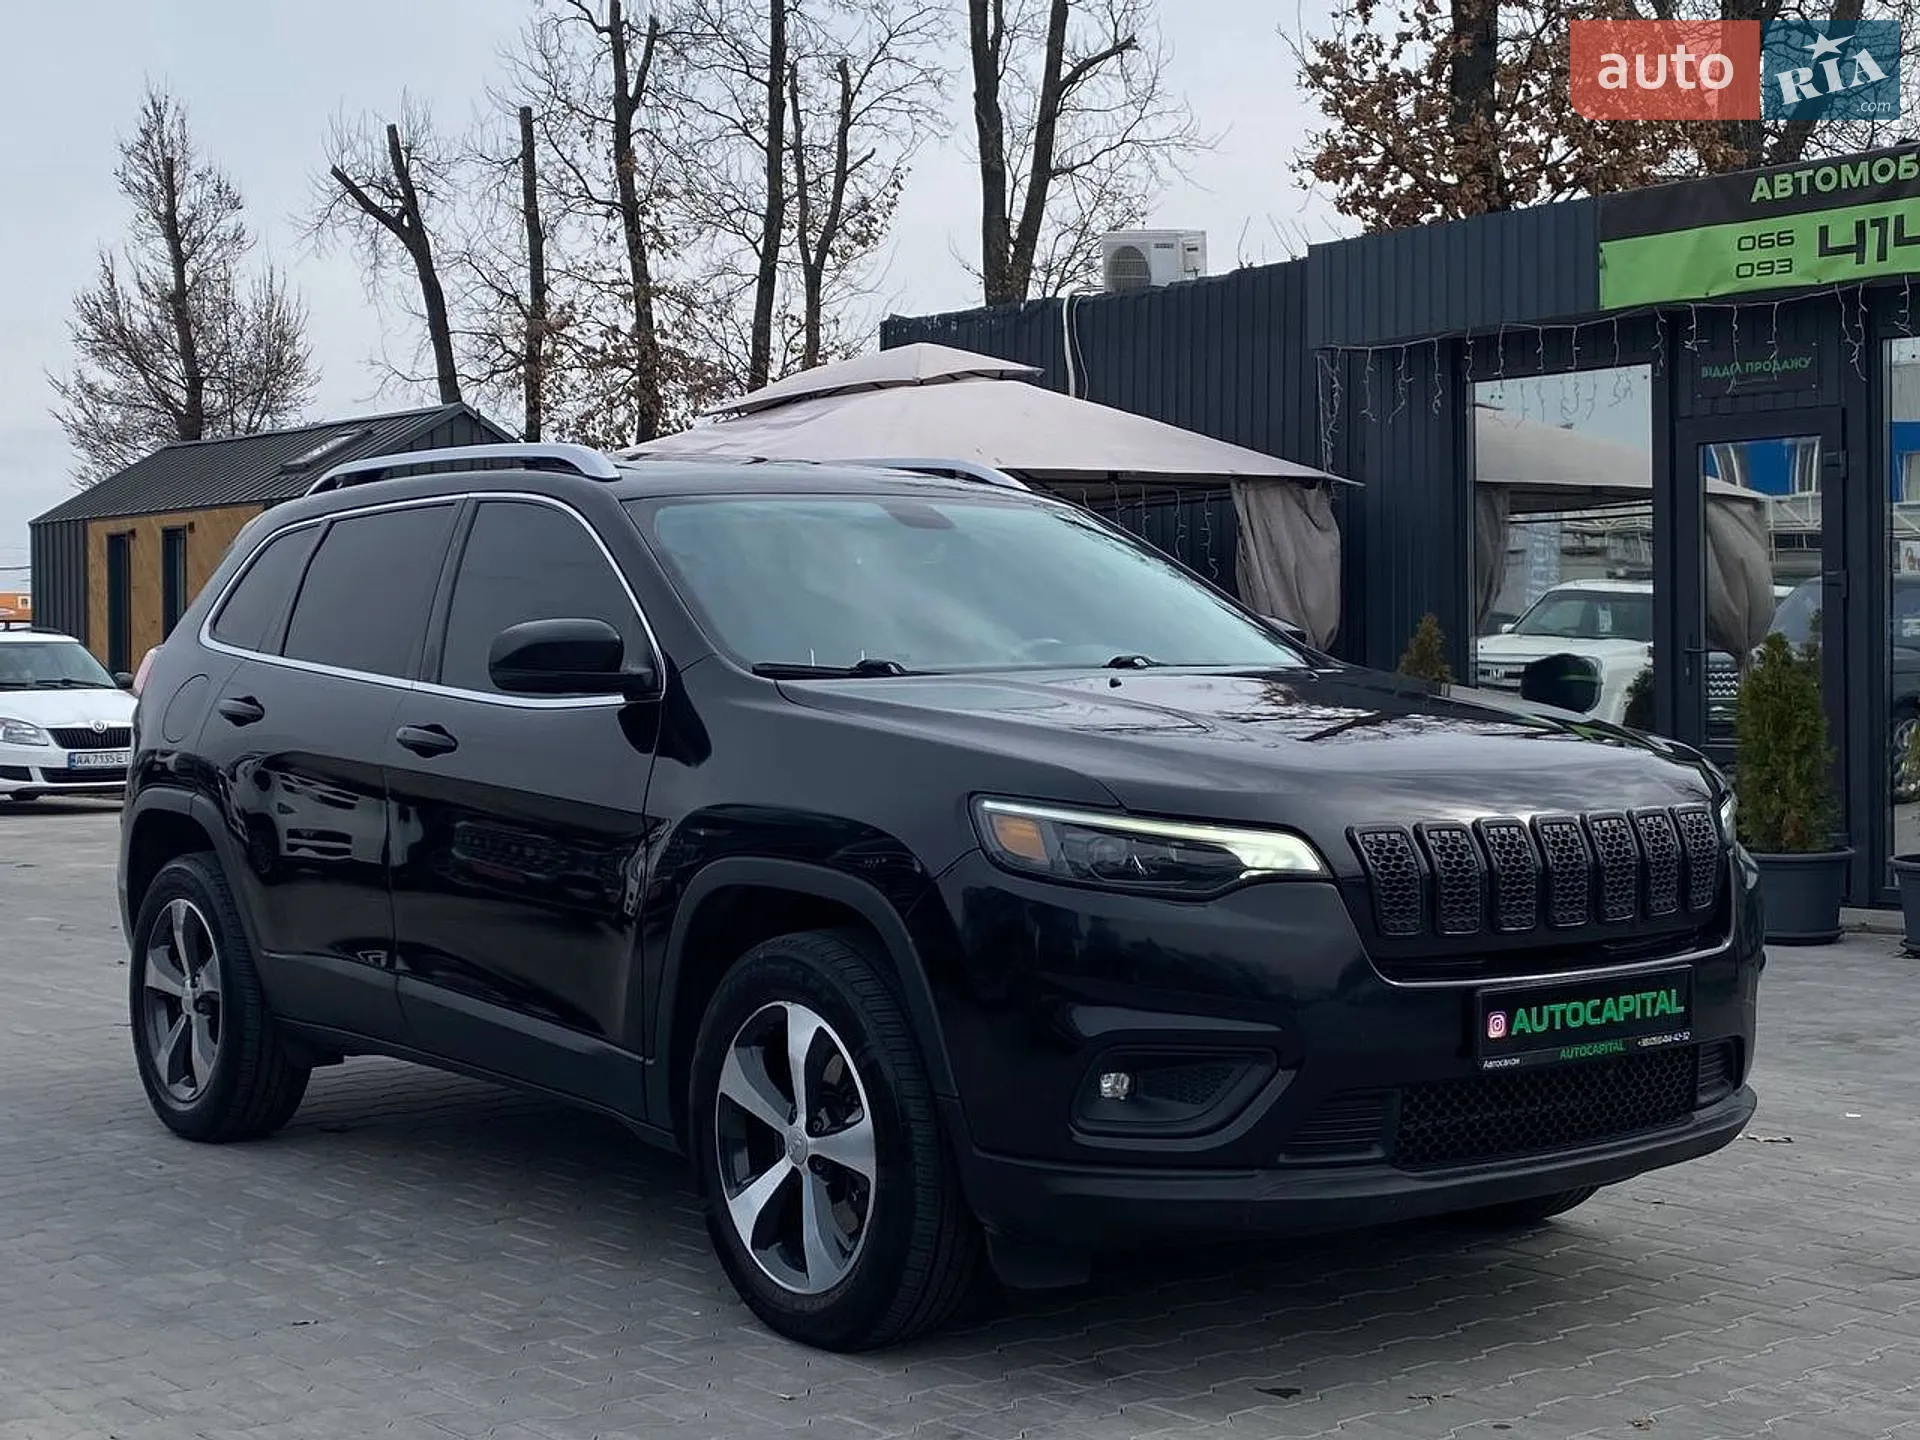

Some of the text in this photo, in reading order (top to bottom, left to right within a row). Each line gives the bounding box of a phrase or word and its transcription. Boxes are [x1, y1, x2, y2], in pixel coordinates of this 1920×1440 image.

[1736, 229, 1795, 251] 066
[1735, 257, 1793, 279] 093
[1511, 988, 1685, 1036] AUTOCAPITAL
[1559, 1040, 1626, 1060] AUTOCAPITAL
